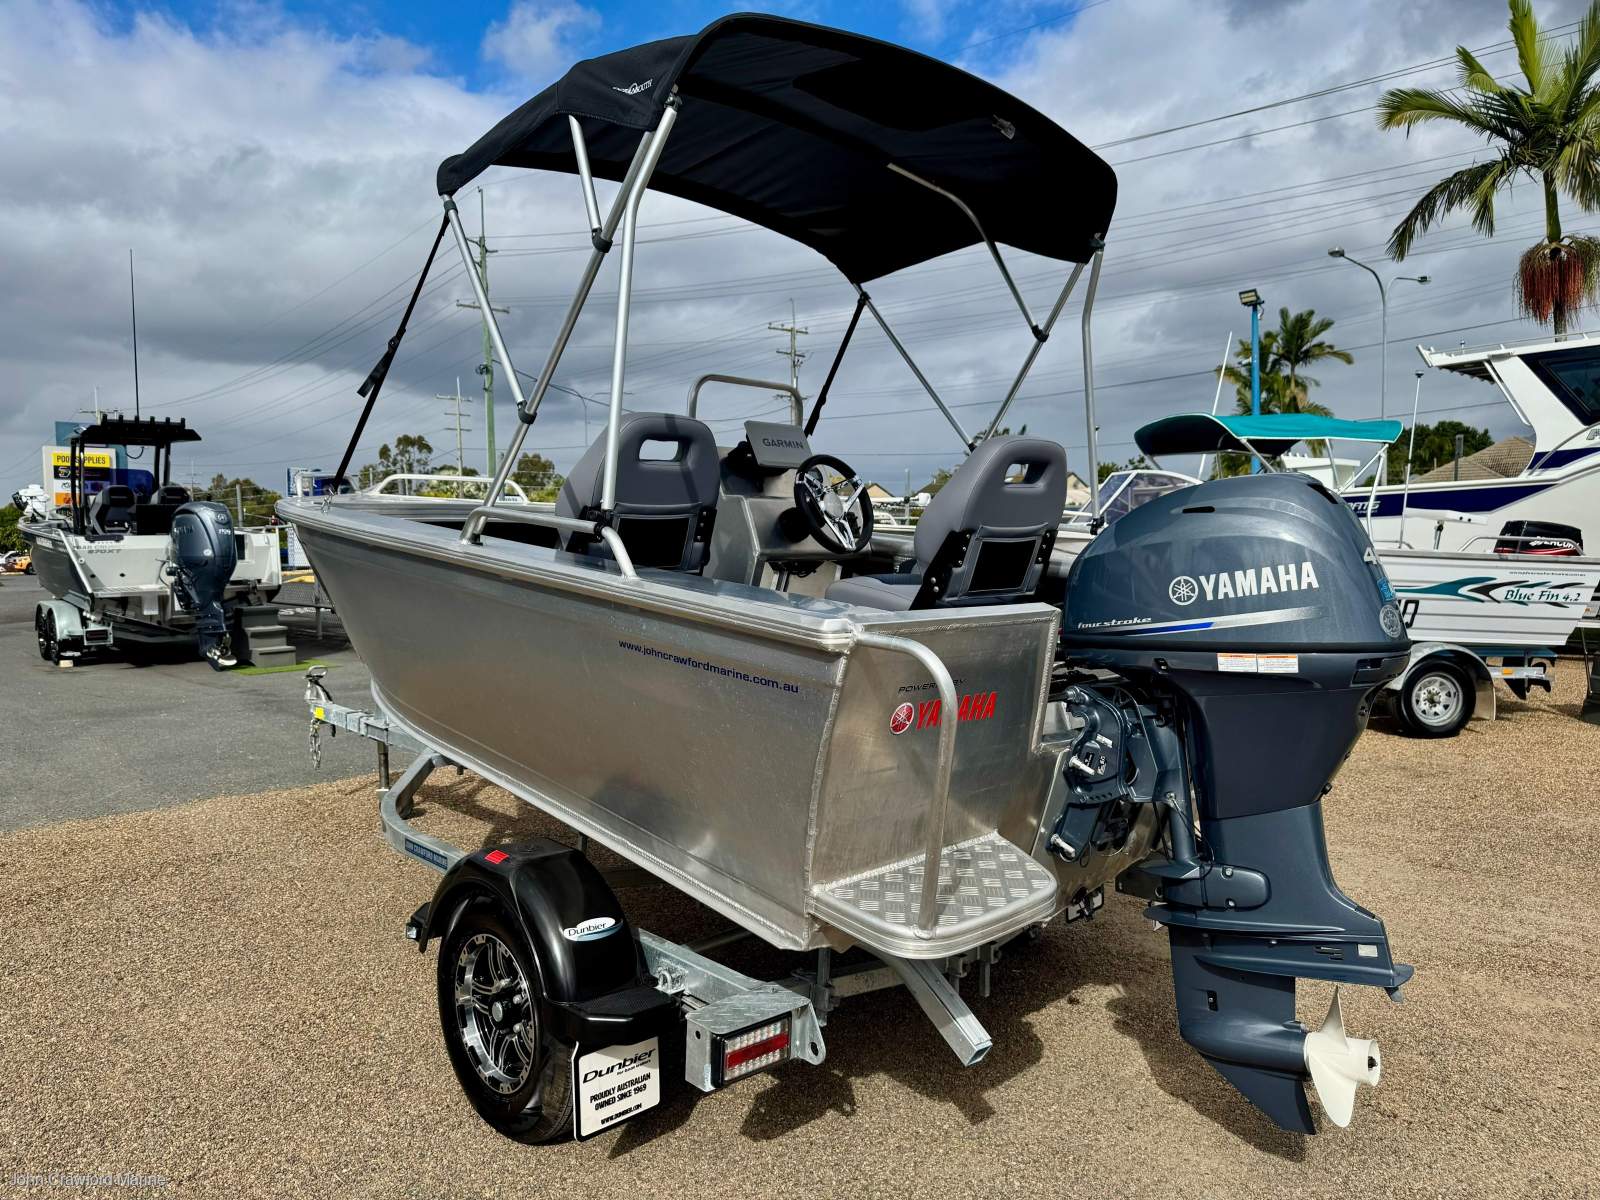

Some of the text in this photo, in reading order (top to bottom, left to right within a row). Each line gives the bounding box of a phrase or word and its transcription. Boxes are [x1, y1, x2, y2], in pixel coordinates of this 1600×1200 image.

[762, 438, 804, 449] GARMIN
[56, 455, 106, 465] POO SPPLIES
[1199, 562, 1319, 600] YAMAHA
[1504, 588, 1581, 602] Blue Fin 4.2
[618, 639, 799, 693] www.johncrawfordmarine.com.au
[898, 682, 939, 694] POWER
[916, 691, 999, 731] YAAHA
[568, 922, 607, 936] Dunbier
[583, 1048, 656, 1084] Dunbier
[590, 1072, 651, 1103] PROUDLY AUSTRALIAN
[595, 1083, 647, 1111] OWNED SINCE 1969
